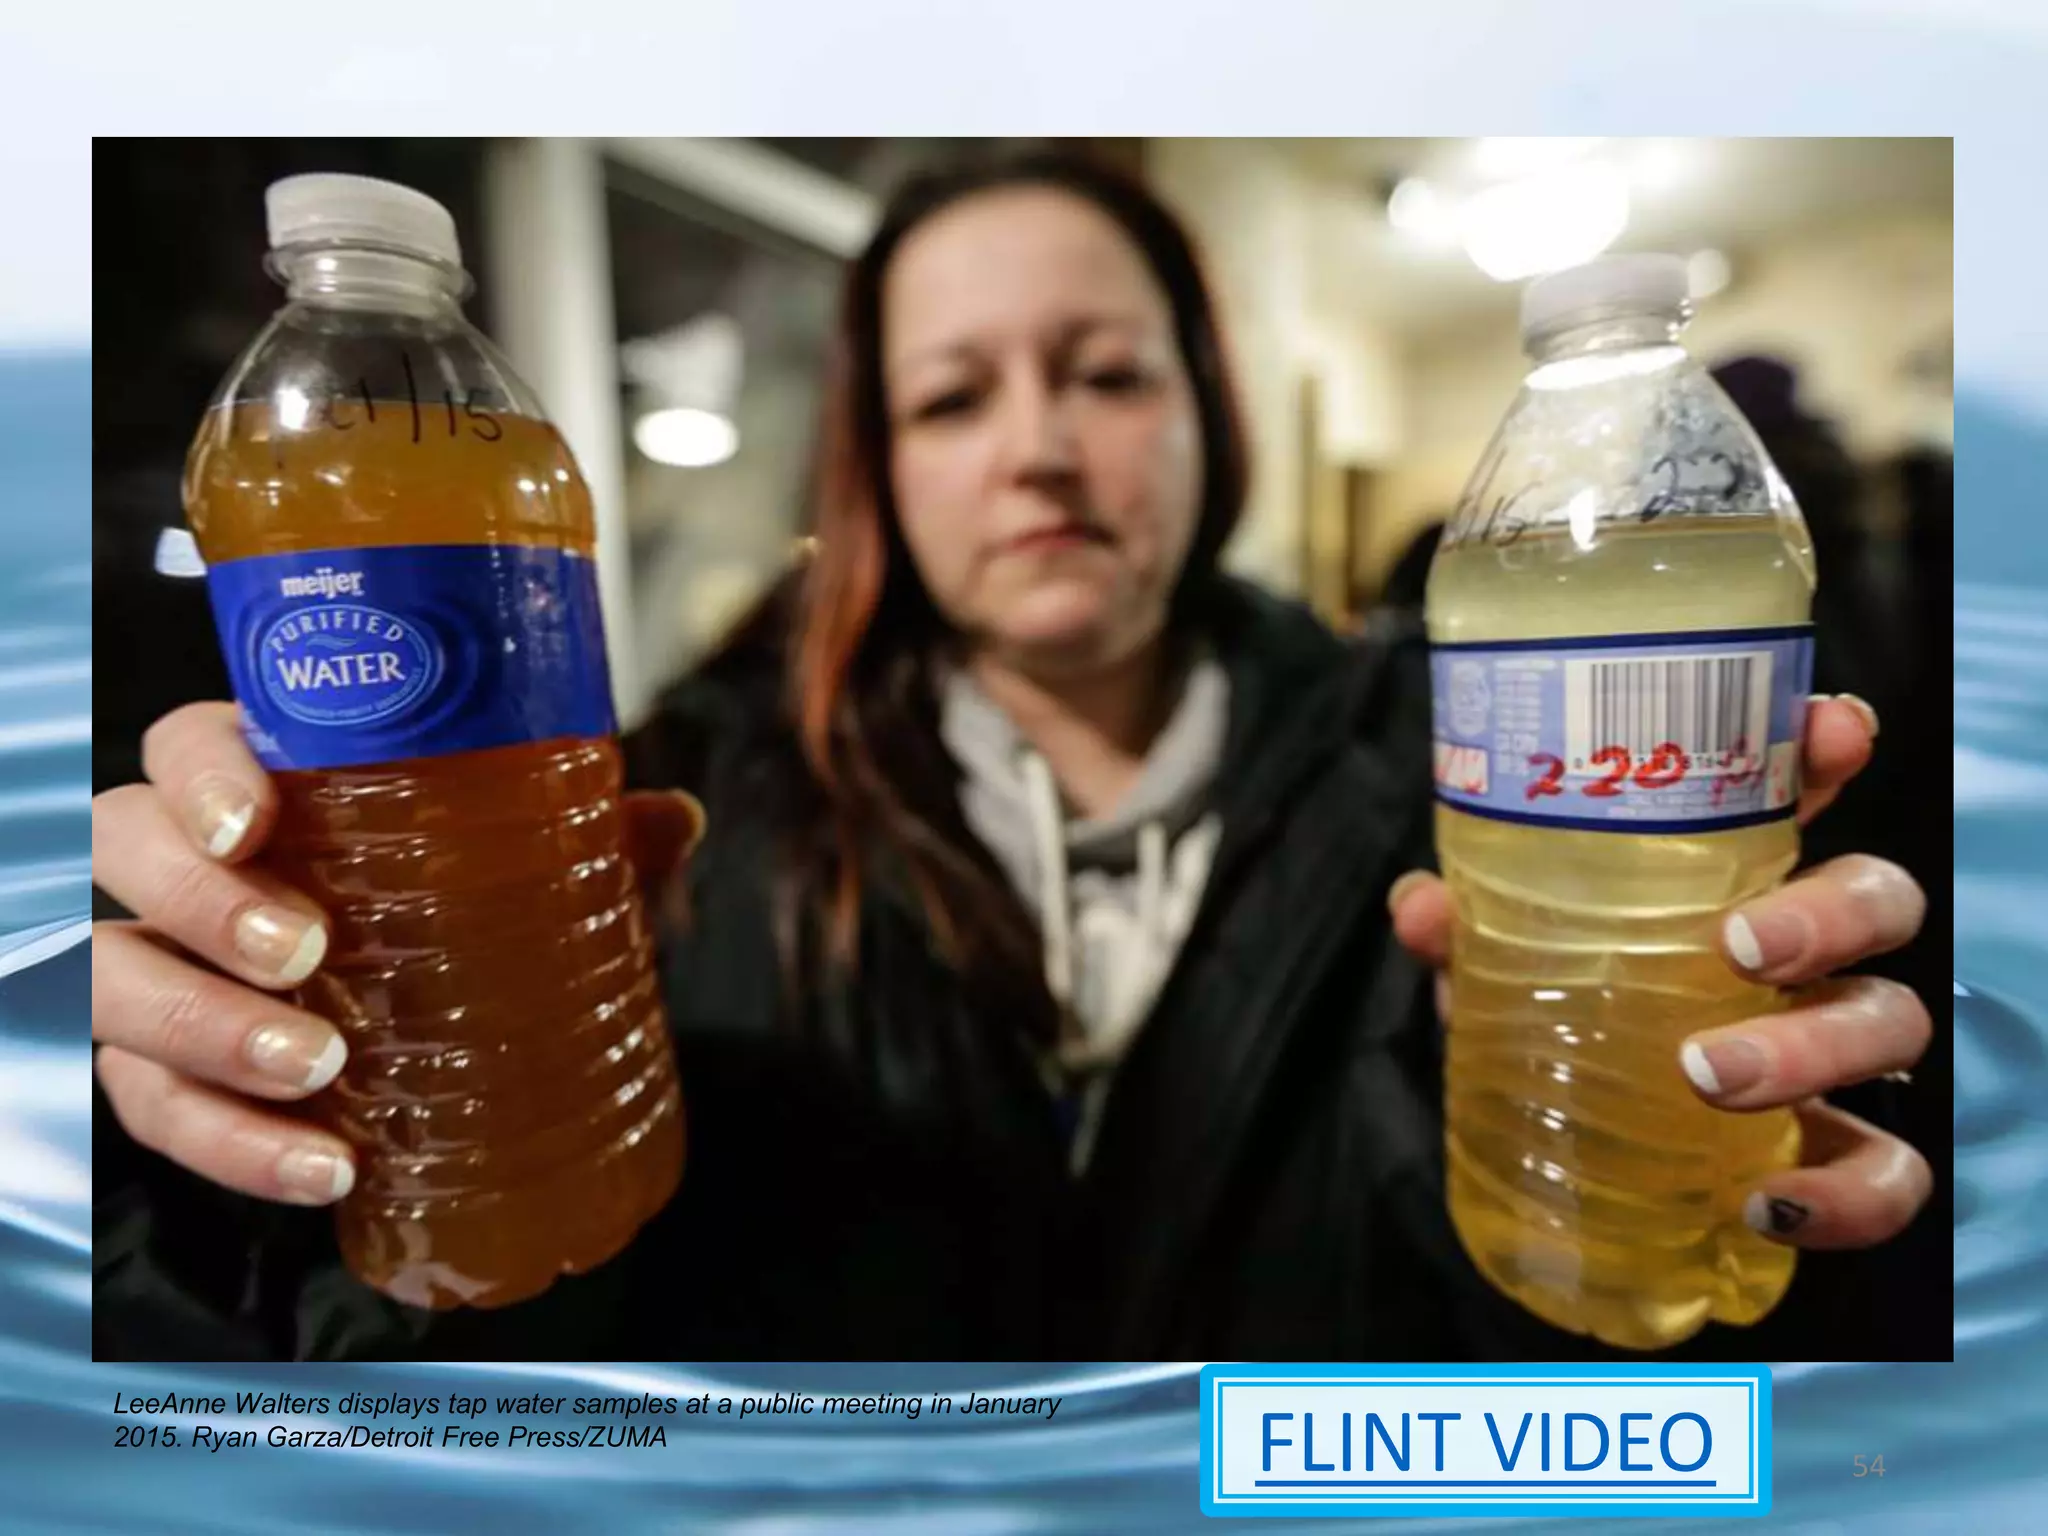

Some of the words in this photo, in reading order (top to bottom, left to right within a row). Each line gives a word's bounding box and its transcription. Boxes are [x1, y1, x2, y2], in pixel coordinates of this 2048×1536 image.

[280, 567, 365, 600] meijer
[270, 610, 404, 654] PURIFIED
[276, 651, 407, 692] WATER
